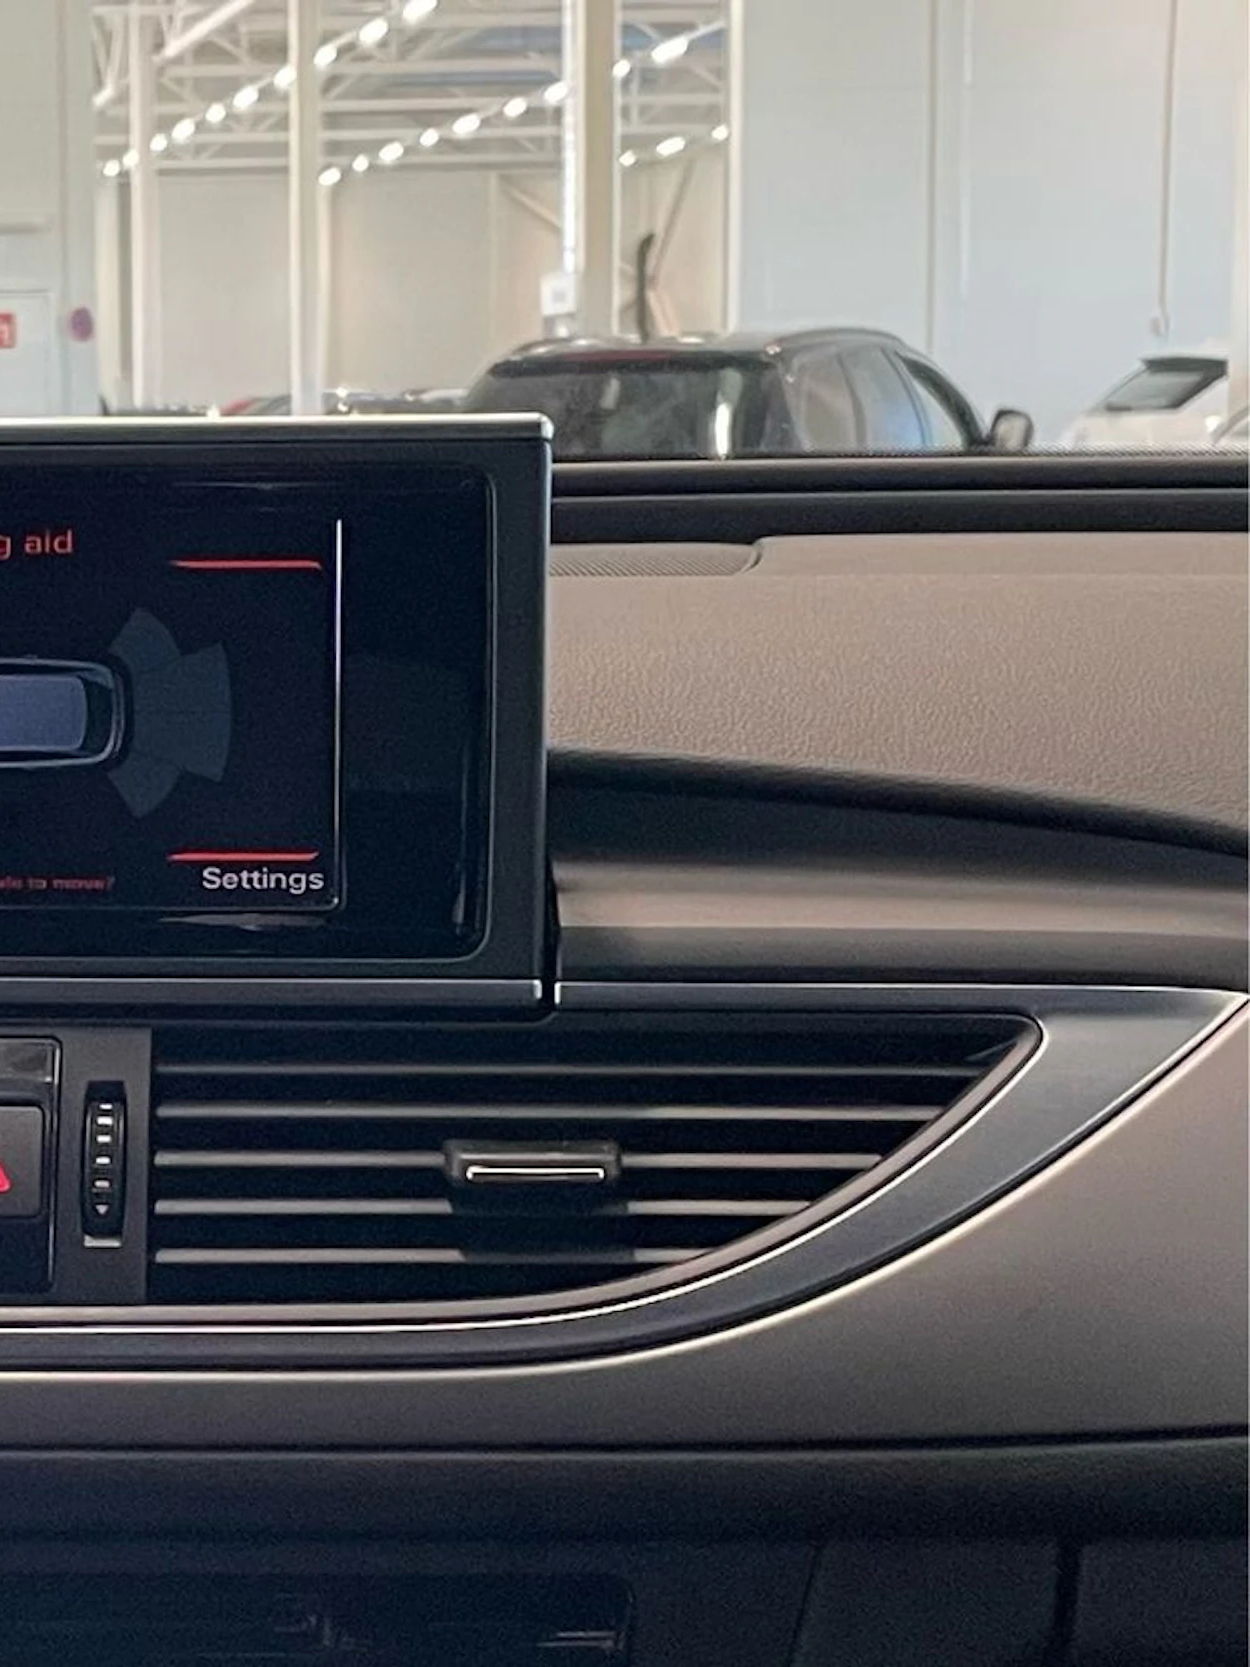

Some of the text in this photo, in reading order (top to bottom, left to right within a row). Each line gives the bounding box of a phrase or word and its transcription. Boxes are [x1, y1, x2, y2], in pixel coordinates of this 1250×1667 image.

[24, 528, 73, 554] aid
[28, 874, 47, 890] to
[201, 866, 325, 895] Settings
